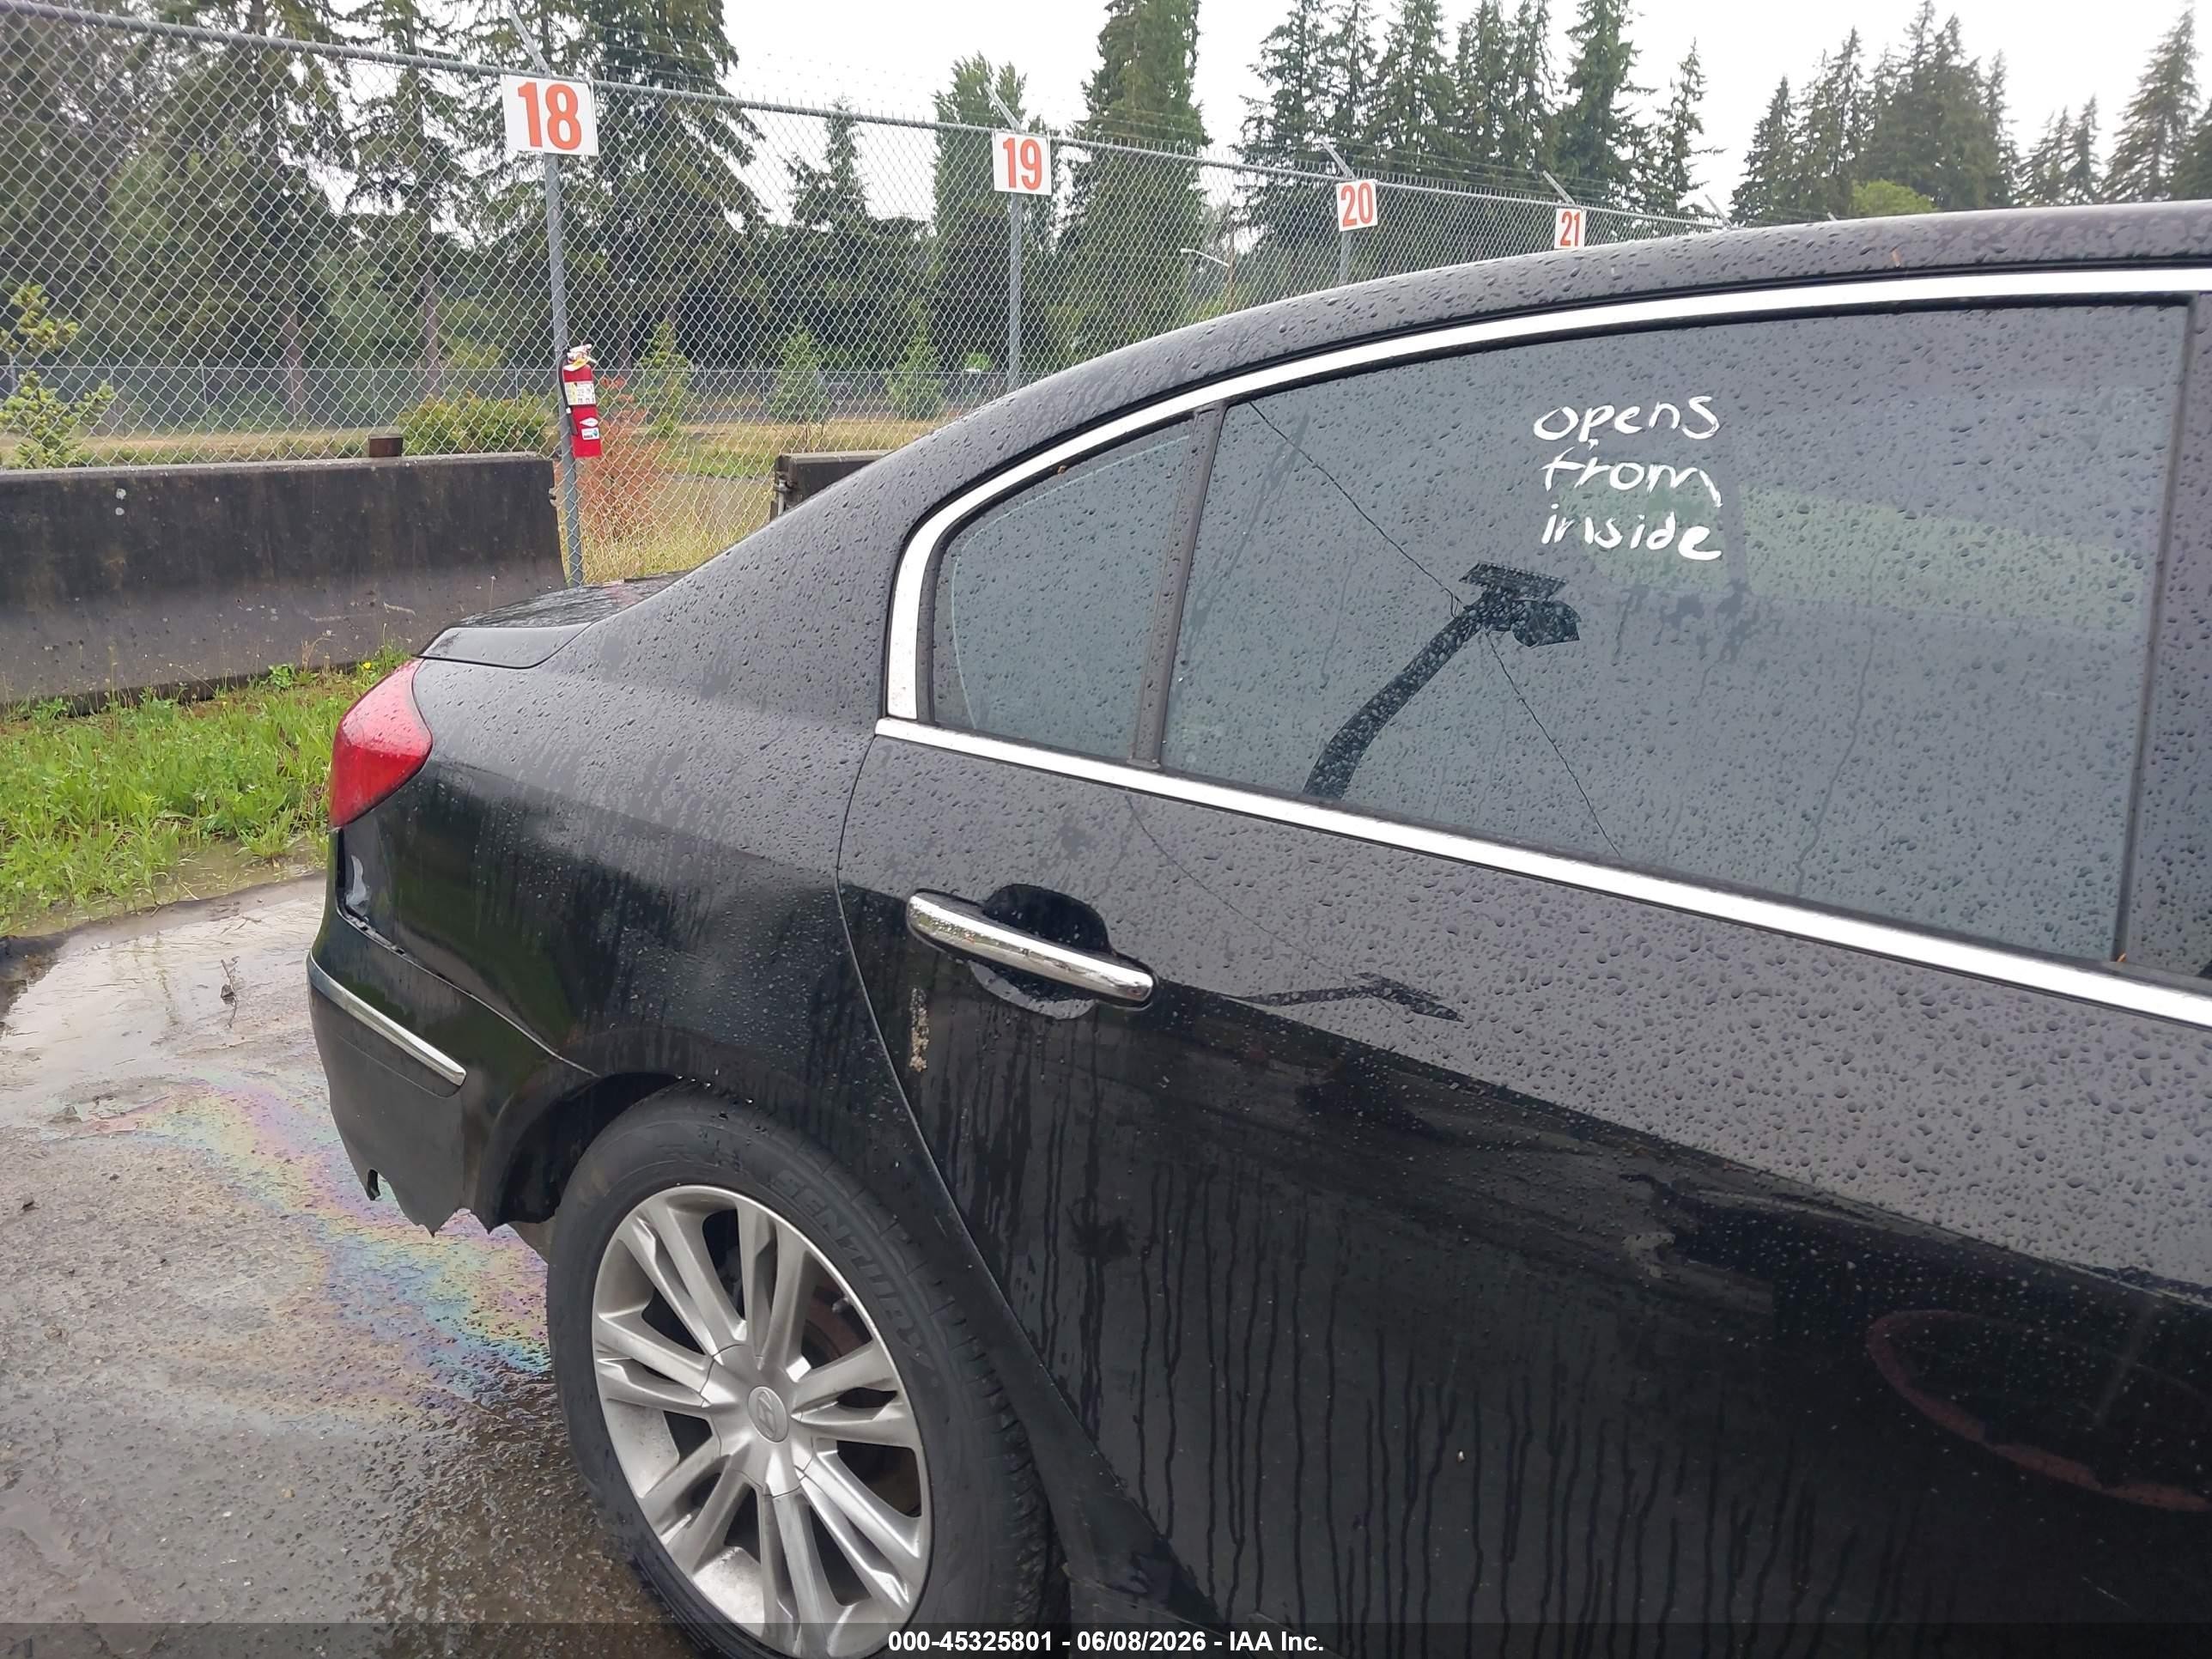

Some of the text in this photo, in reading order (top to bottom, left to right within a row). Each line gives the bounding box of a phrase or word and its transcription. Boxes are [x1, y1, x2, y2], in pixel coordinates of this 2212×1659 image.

[517, 82, 582, 150] 18
[1002, 137, 1043, 191] 19
[1340, 182, 1374, 228] 20
[1559, 210, 1581, 247] 21
[1540, 446, 1723, 508] from
[1540, 502, 1723, 562] inside
